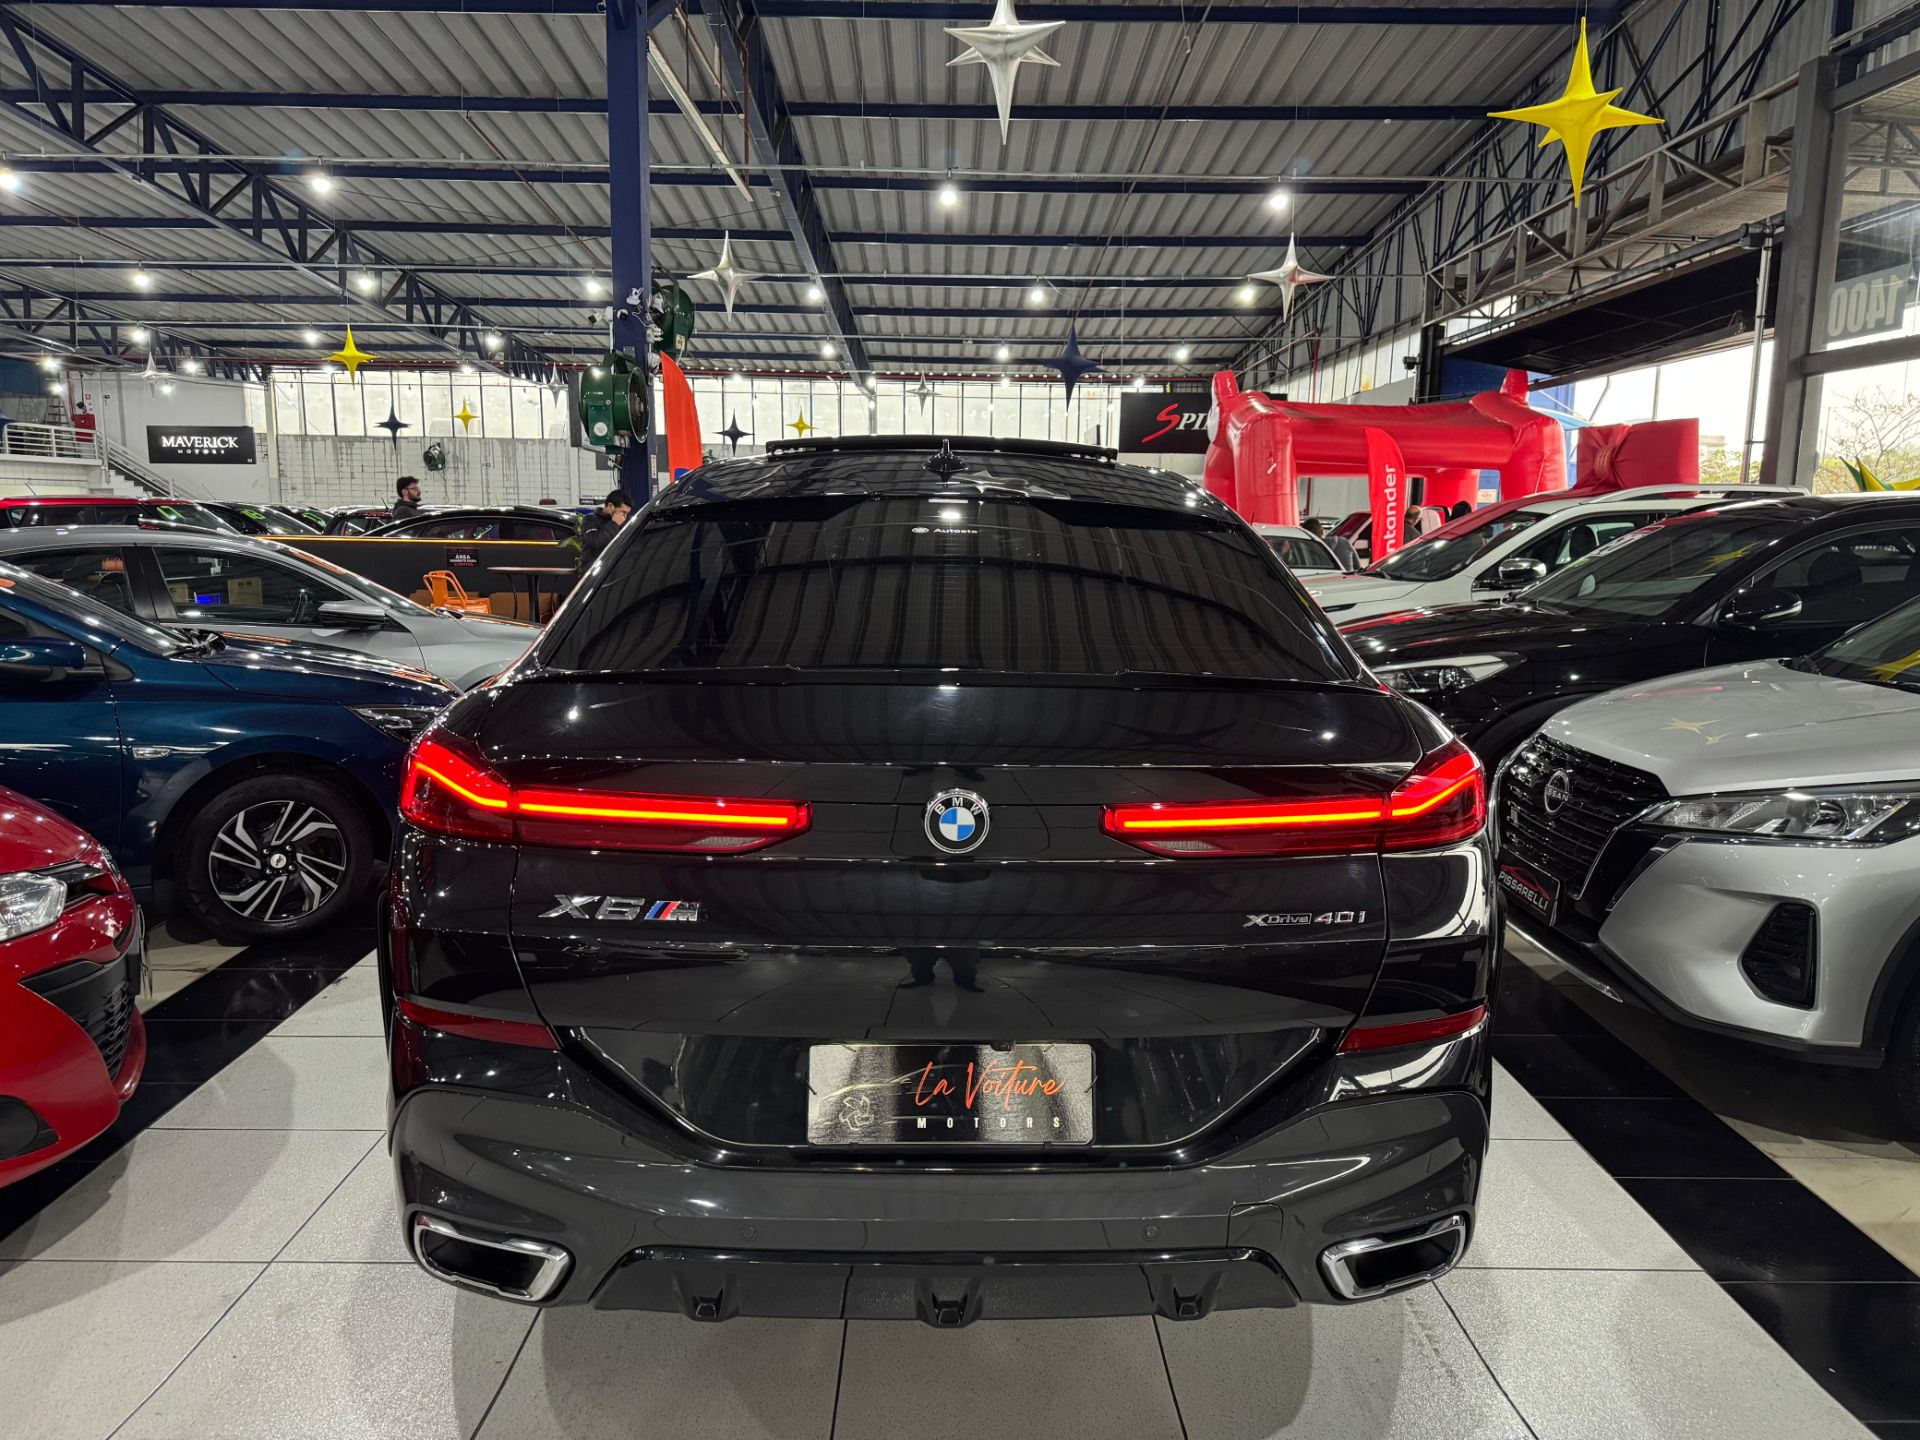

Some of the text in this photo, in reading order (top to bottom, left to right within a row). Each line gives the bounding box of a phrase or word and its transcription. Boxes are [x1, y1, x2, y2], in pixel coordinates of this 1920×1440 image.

[1142, 403, 1209, 443] SPI
[161, 435, 239, 448] MAVERICK
[1545, 784, 1569, 802] NISSAN
[933, 797, 982, 816] BMW
[1498, 870, 1549, 911] PISSARELLI
[538, 894, 646, 921] X6
[915, 1060, 1065, 1111] La Voiture
[917, 1117, 1060, 1129] MOTORS
